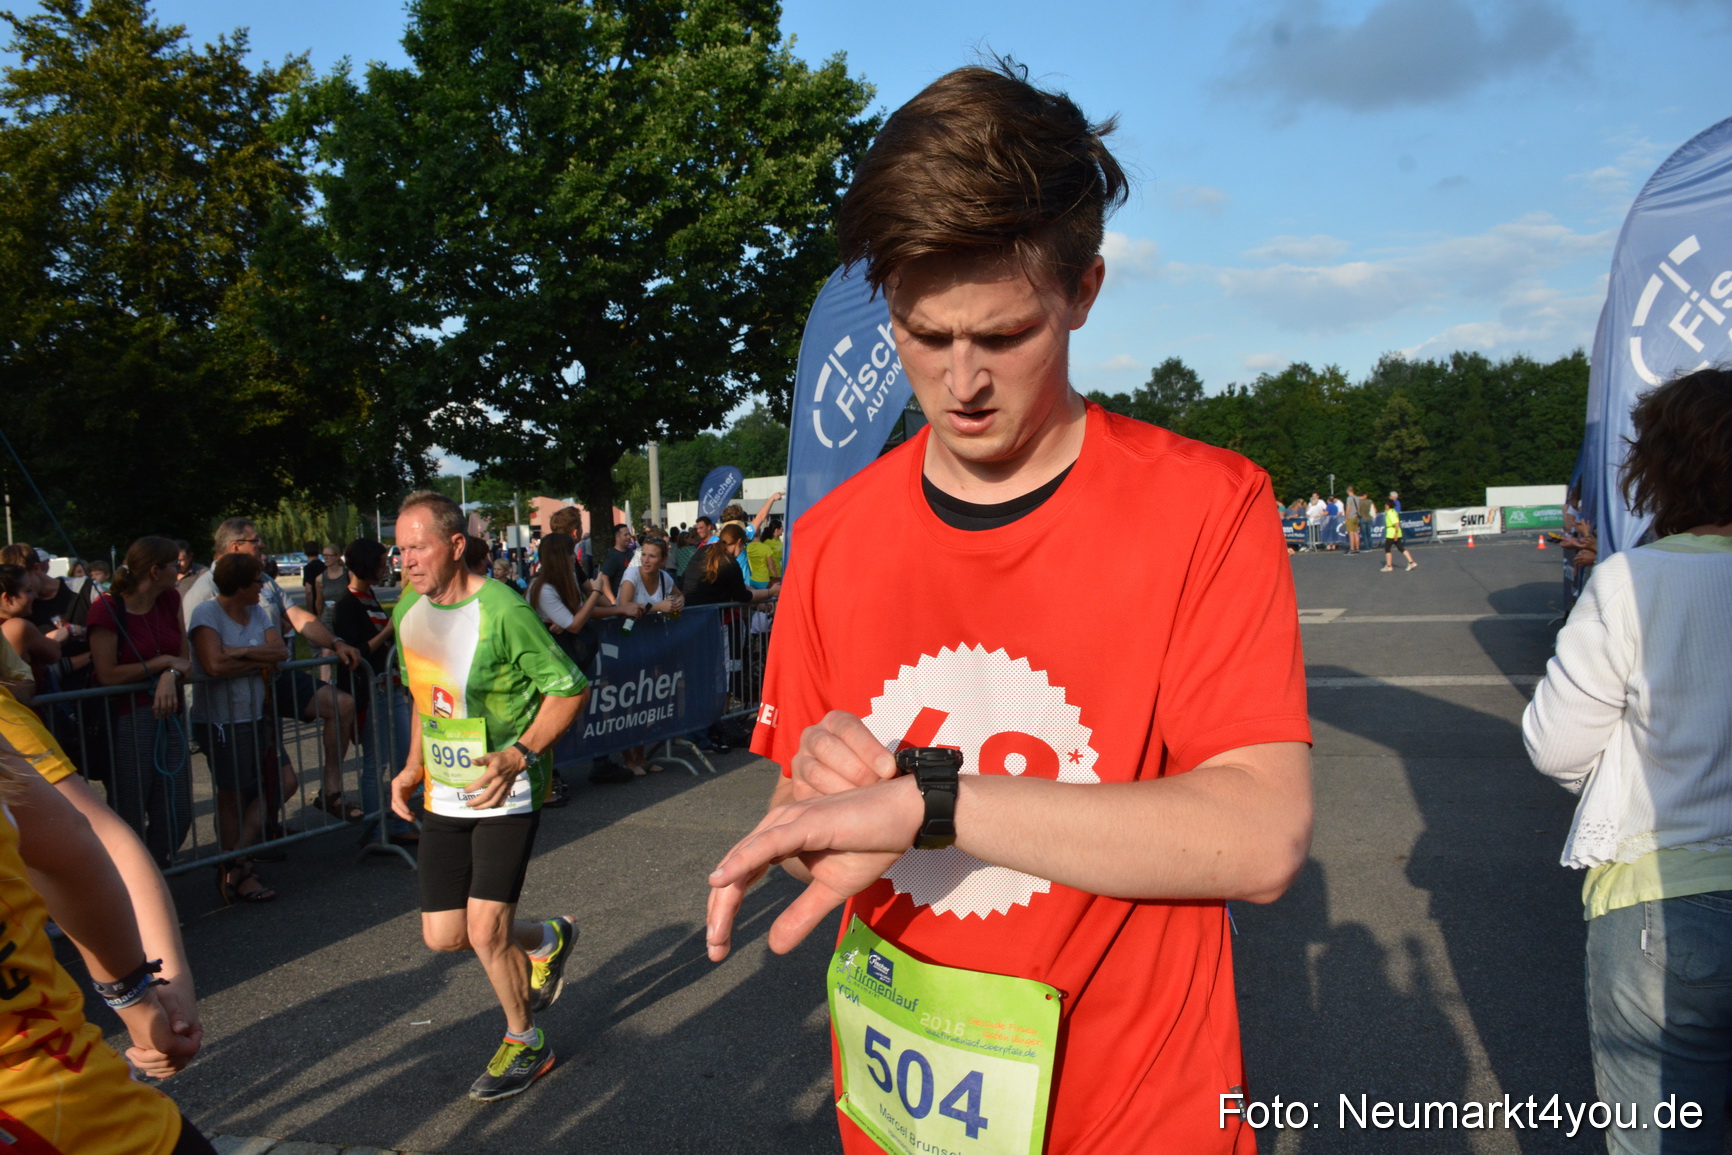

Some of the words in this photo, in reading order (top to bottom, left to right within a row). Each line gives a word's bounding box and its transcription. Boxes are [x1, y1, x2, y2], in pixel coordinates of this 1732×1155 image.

[709, 472, 734, 508] Fischer
[588, 669, 683, 715] ischer
[583, 703, 676, 739] AUTOMOBILE
[432, 743, 471, 768] 996
[854, 966, 919, 1012] firmenlauf
[920, 1012, 966, 1037] 2016
[865, 1025, 988, 1140] 504
[879, 1103, 908, 1138] Marcel
